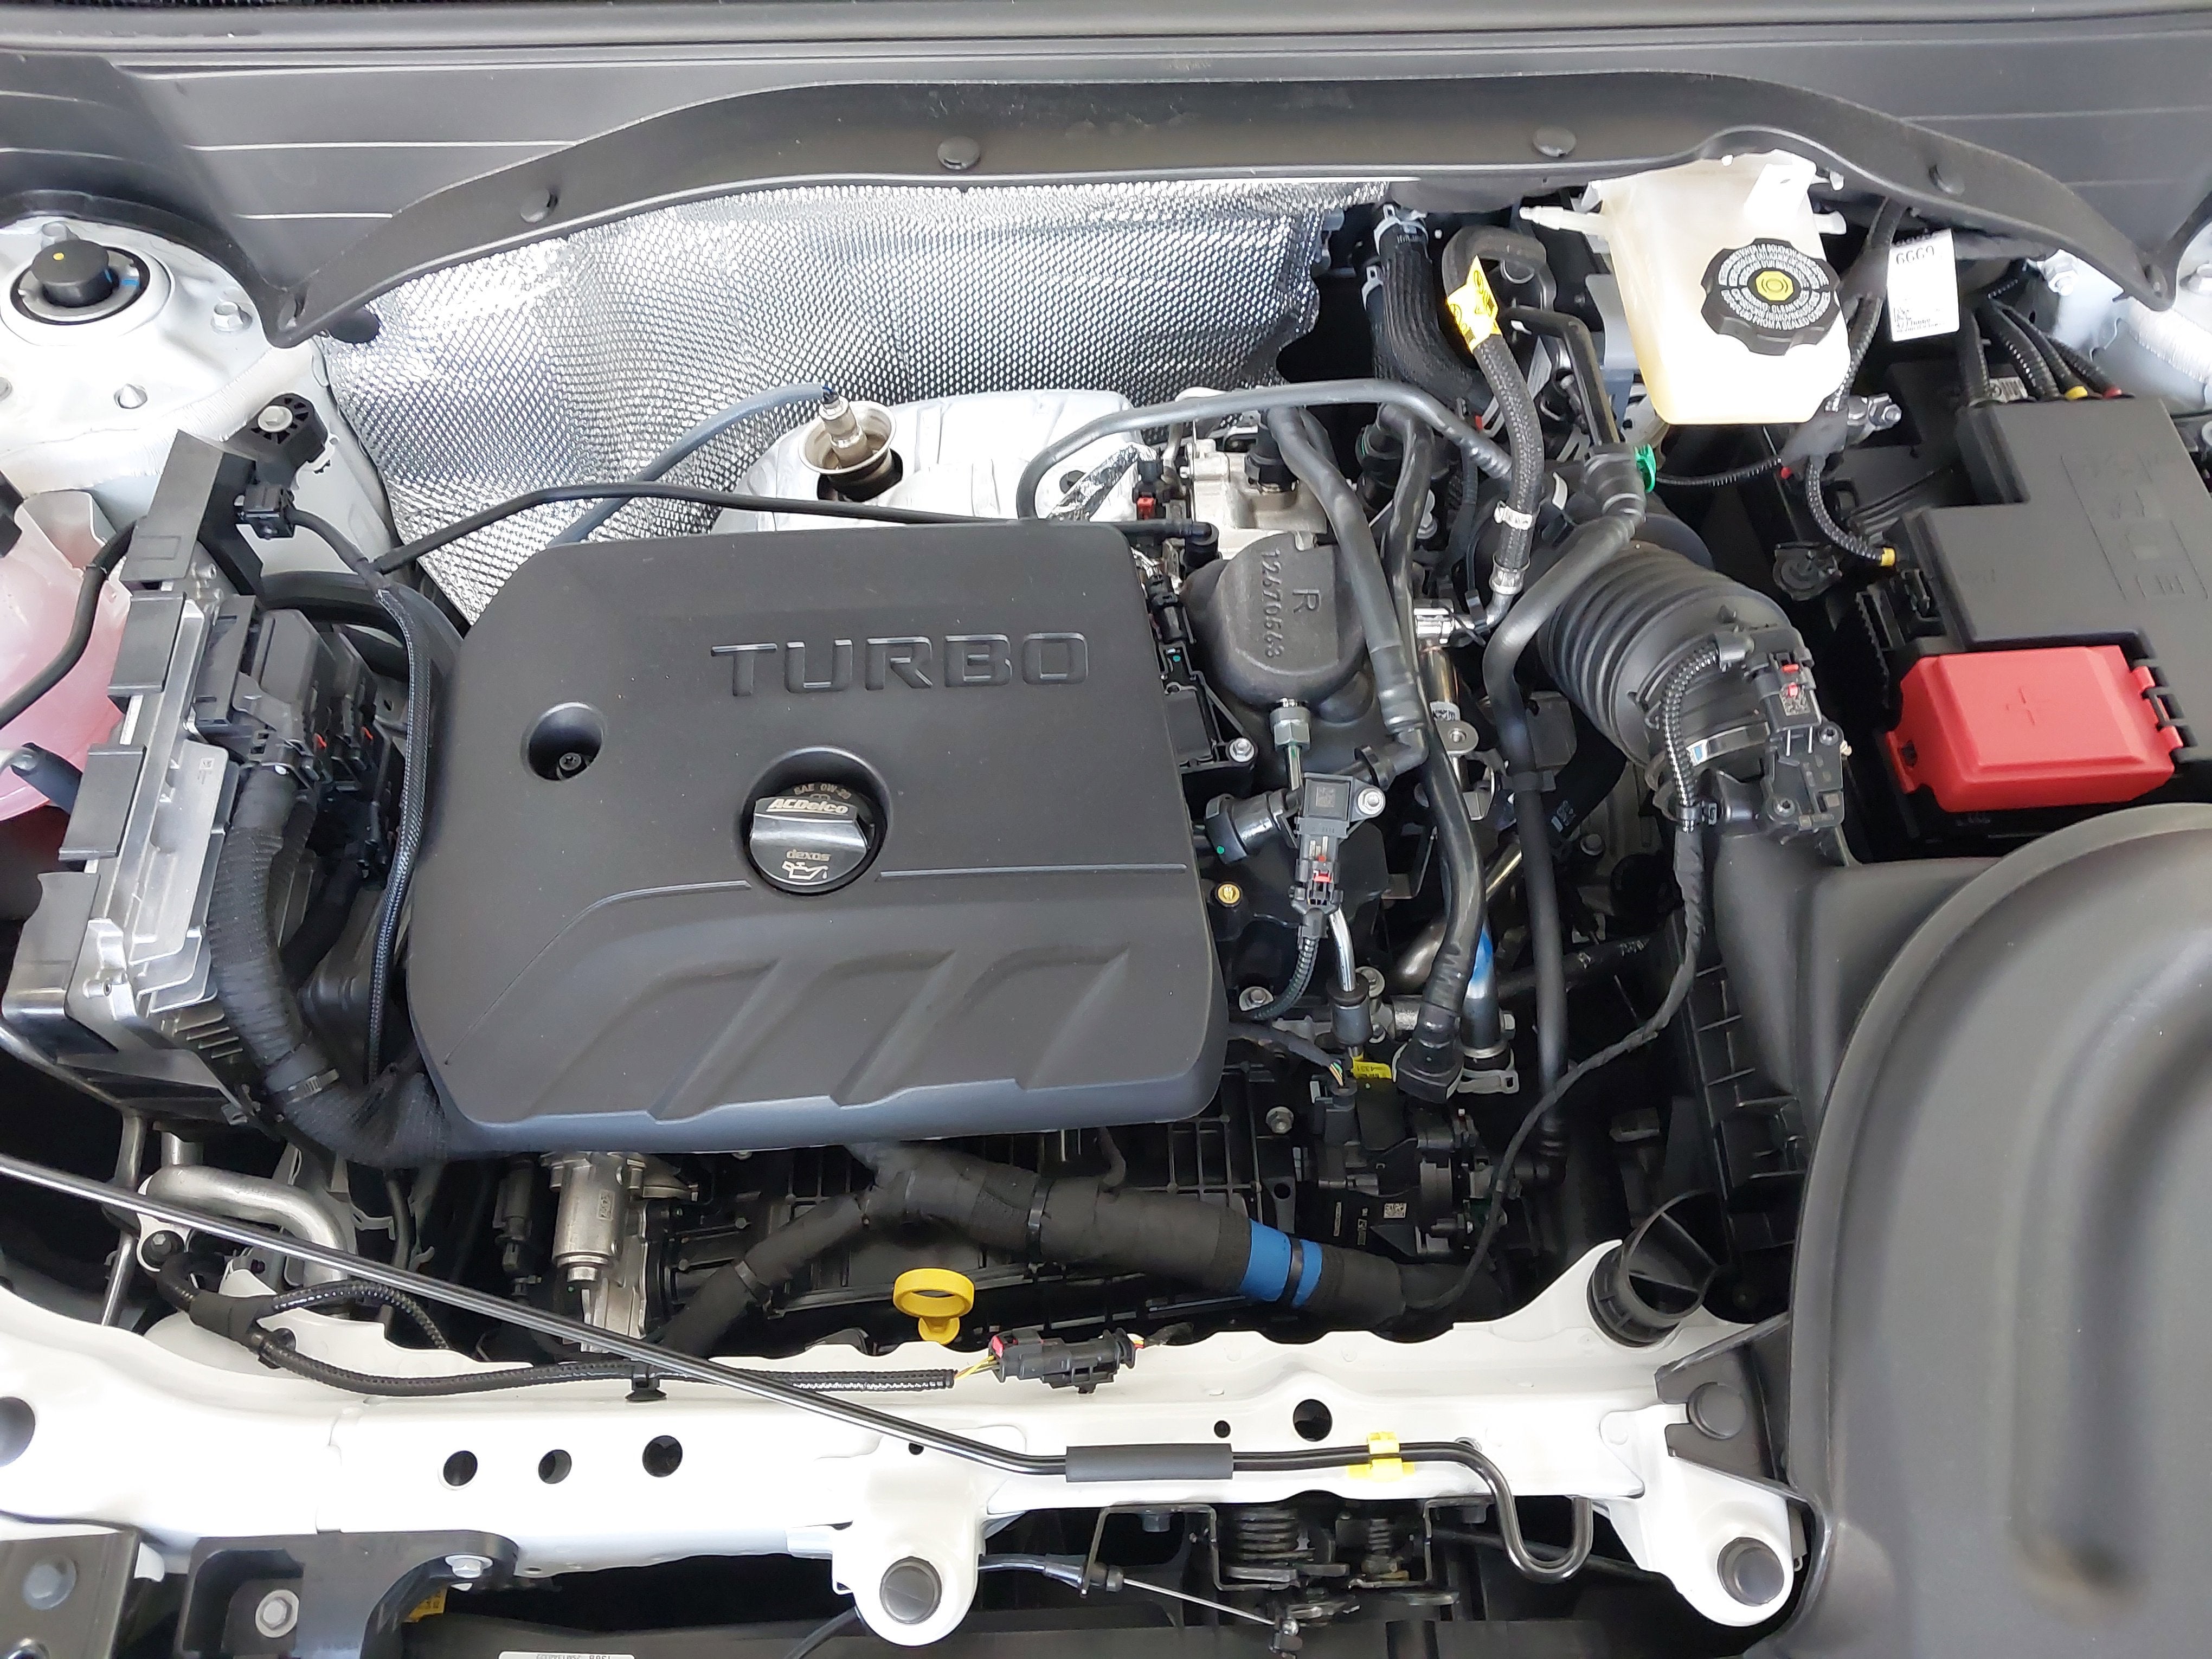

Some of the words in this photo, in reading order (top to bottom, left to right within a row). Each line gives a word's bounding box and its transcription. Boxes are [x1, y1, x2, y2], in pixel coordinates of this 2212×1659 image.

[1293, 589, 1321, 614] R
[711, 632, 1089, 697] TURBO
[768, 799, 848, 814] ACDelco
[786, 848, 832, 862] dexos
